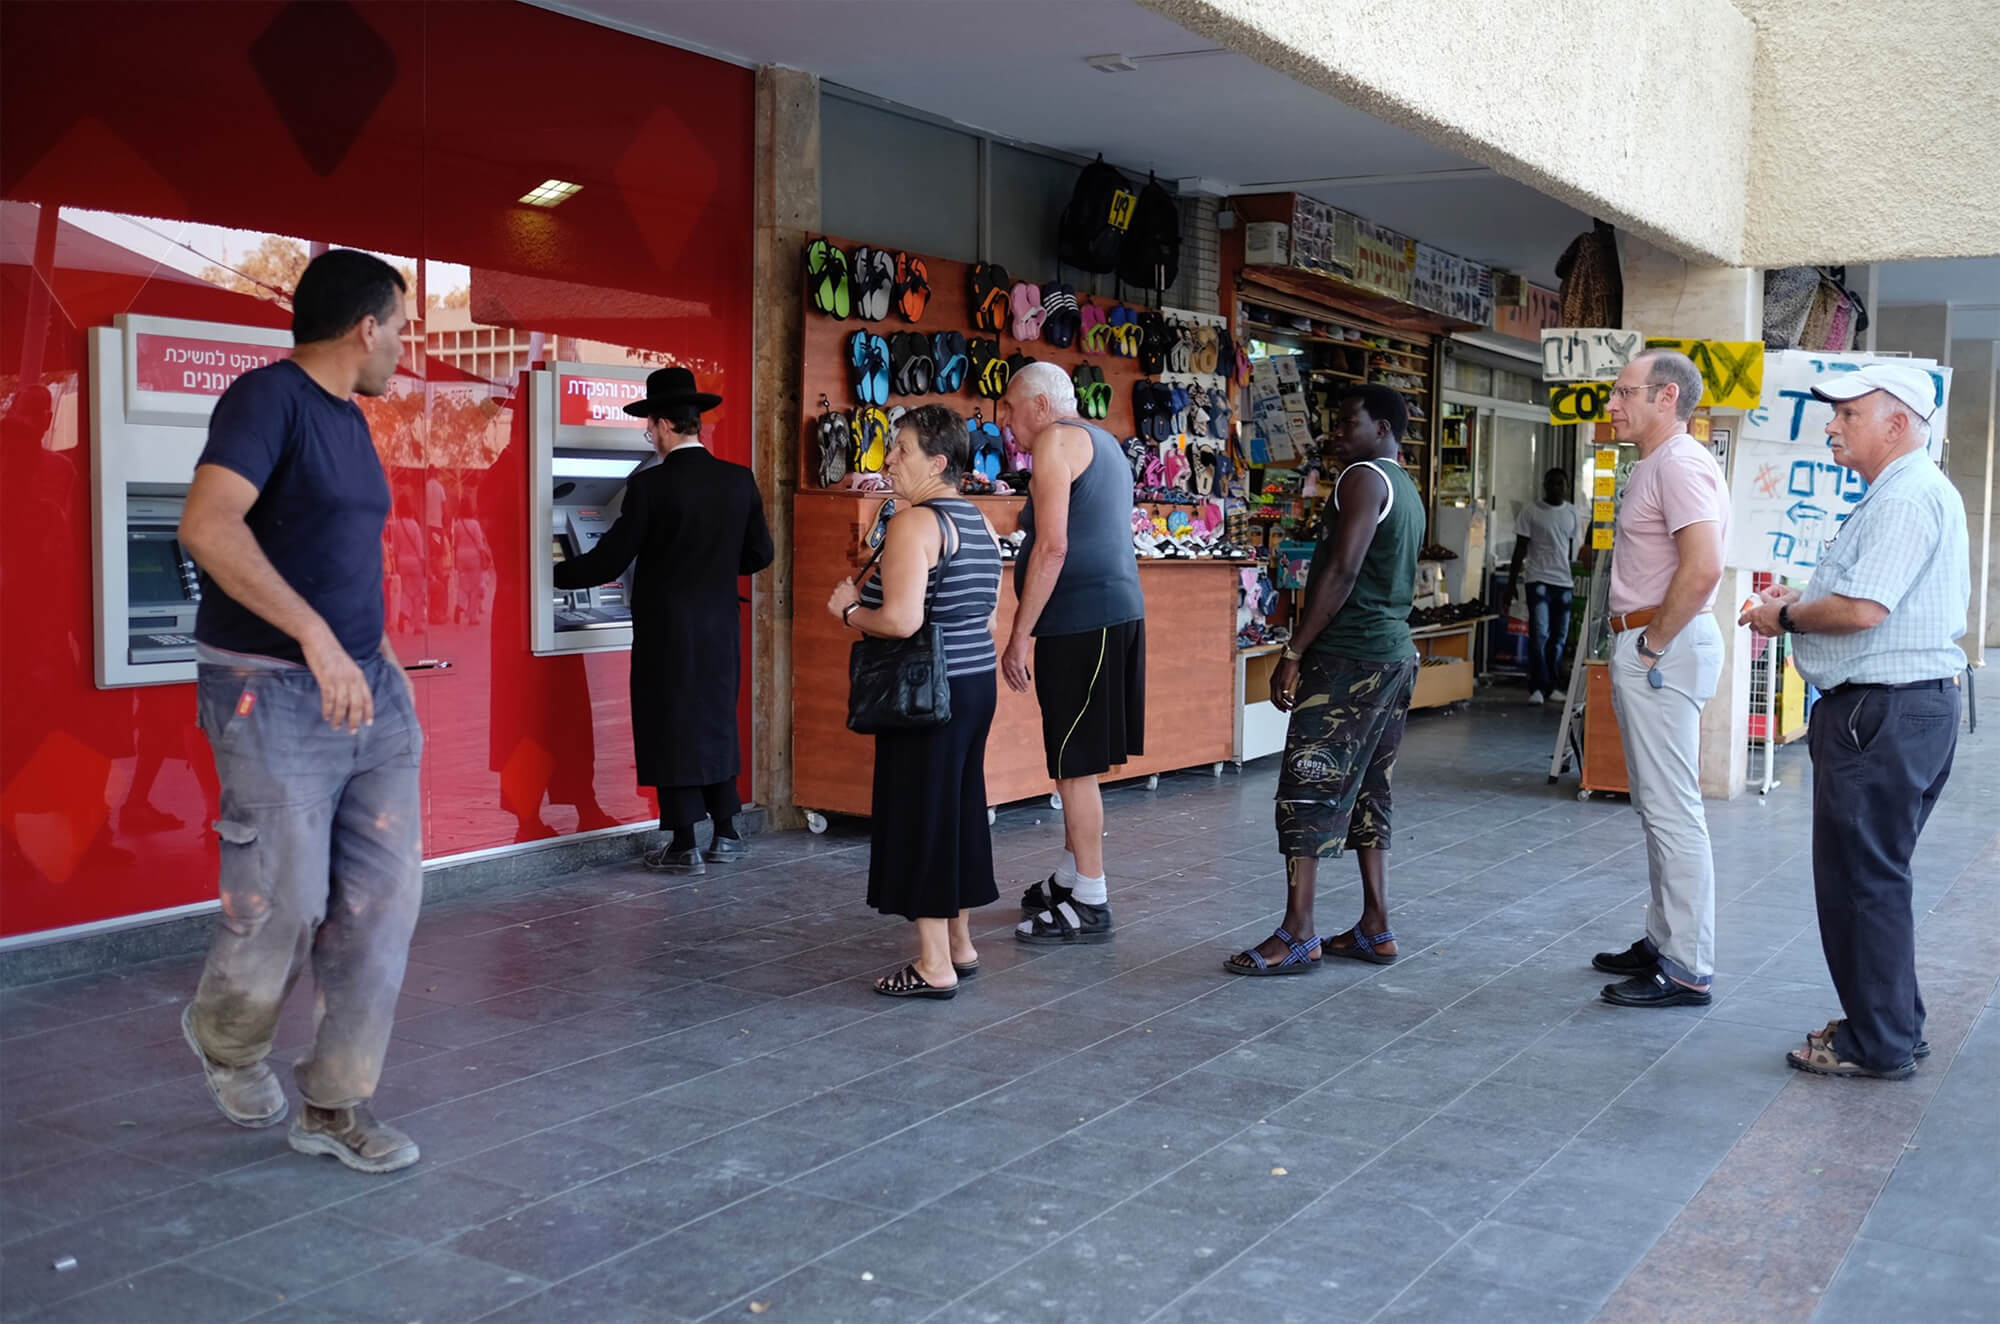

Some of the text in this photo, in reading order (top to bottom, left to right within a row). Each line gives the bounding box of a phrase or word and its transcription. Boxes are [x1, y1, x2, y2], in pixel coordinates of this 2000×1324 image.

[163, 348, 225, 367] למשיכת
[184, 371, 237, 390] ומנים
[1646, 341, 1762, 403] AX
[567, 380, 647, 400] שיכה והפקדת
[593, 404, 639, 421] ומנים
[1550, 385, 1612, 420] COP
[1787, 459, 1869, 503] פרים
